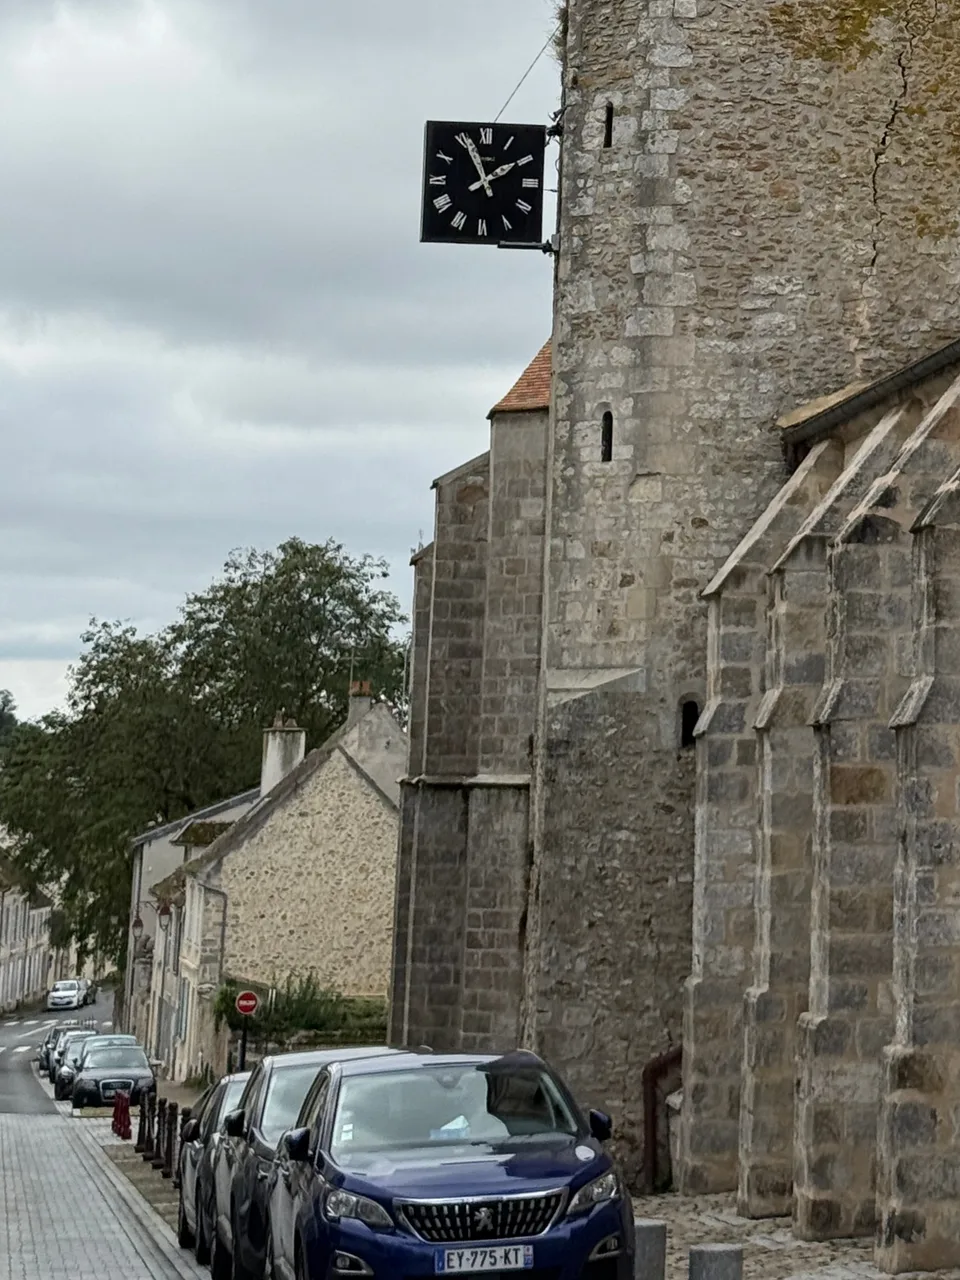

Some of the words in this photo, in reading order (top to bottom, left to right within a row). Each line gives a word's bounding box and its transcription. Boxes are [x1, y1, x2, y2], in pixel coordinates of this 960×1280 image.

[479, 127, 493, 145] XII
[503, 135, 514, 151] I
[436, 149, 453, 165] X
[516, 154, 533, 166] II
[522, 178, 539, 188] III
[446, 1247, 522, 1269] EY-775-KT
